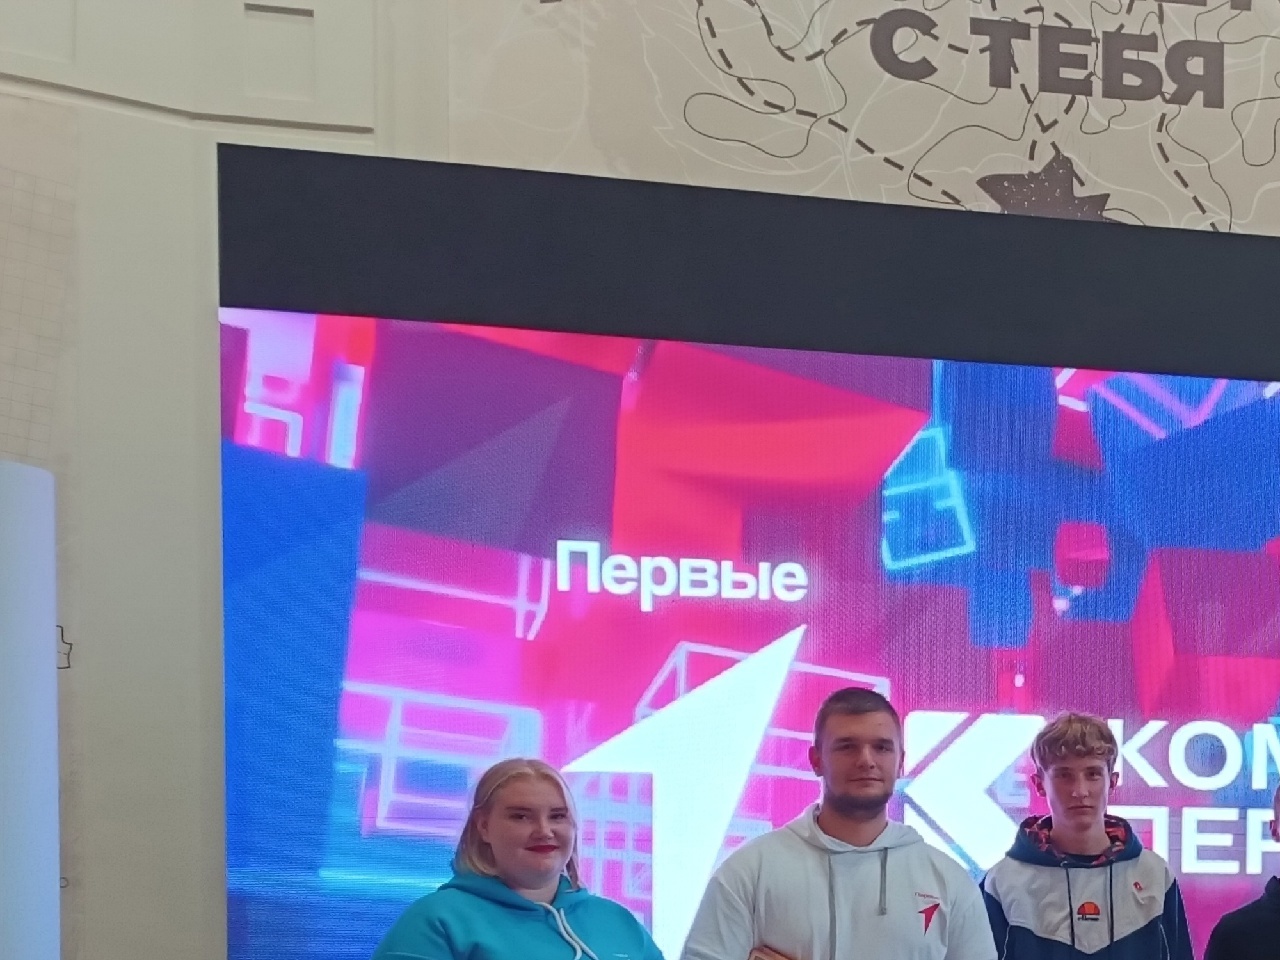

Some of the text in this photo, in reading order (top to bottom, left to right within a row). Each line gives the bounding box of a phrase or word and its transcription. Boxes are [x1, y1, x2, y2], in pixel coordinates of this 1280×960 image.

[870, 8, 1224, 109] С ТЕБЯ
[556, 539, 809, 612] Первые
